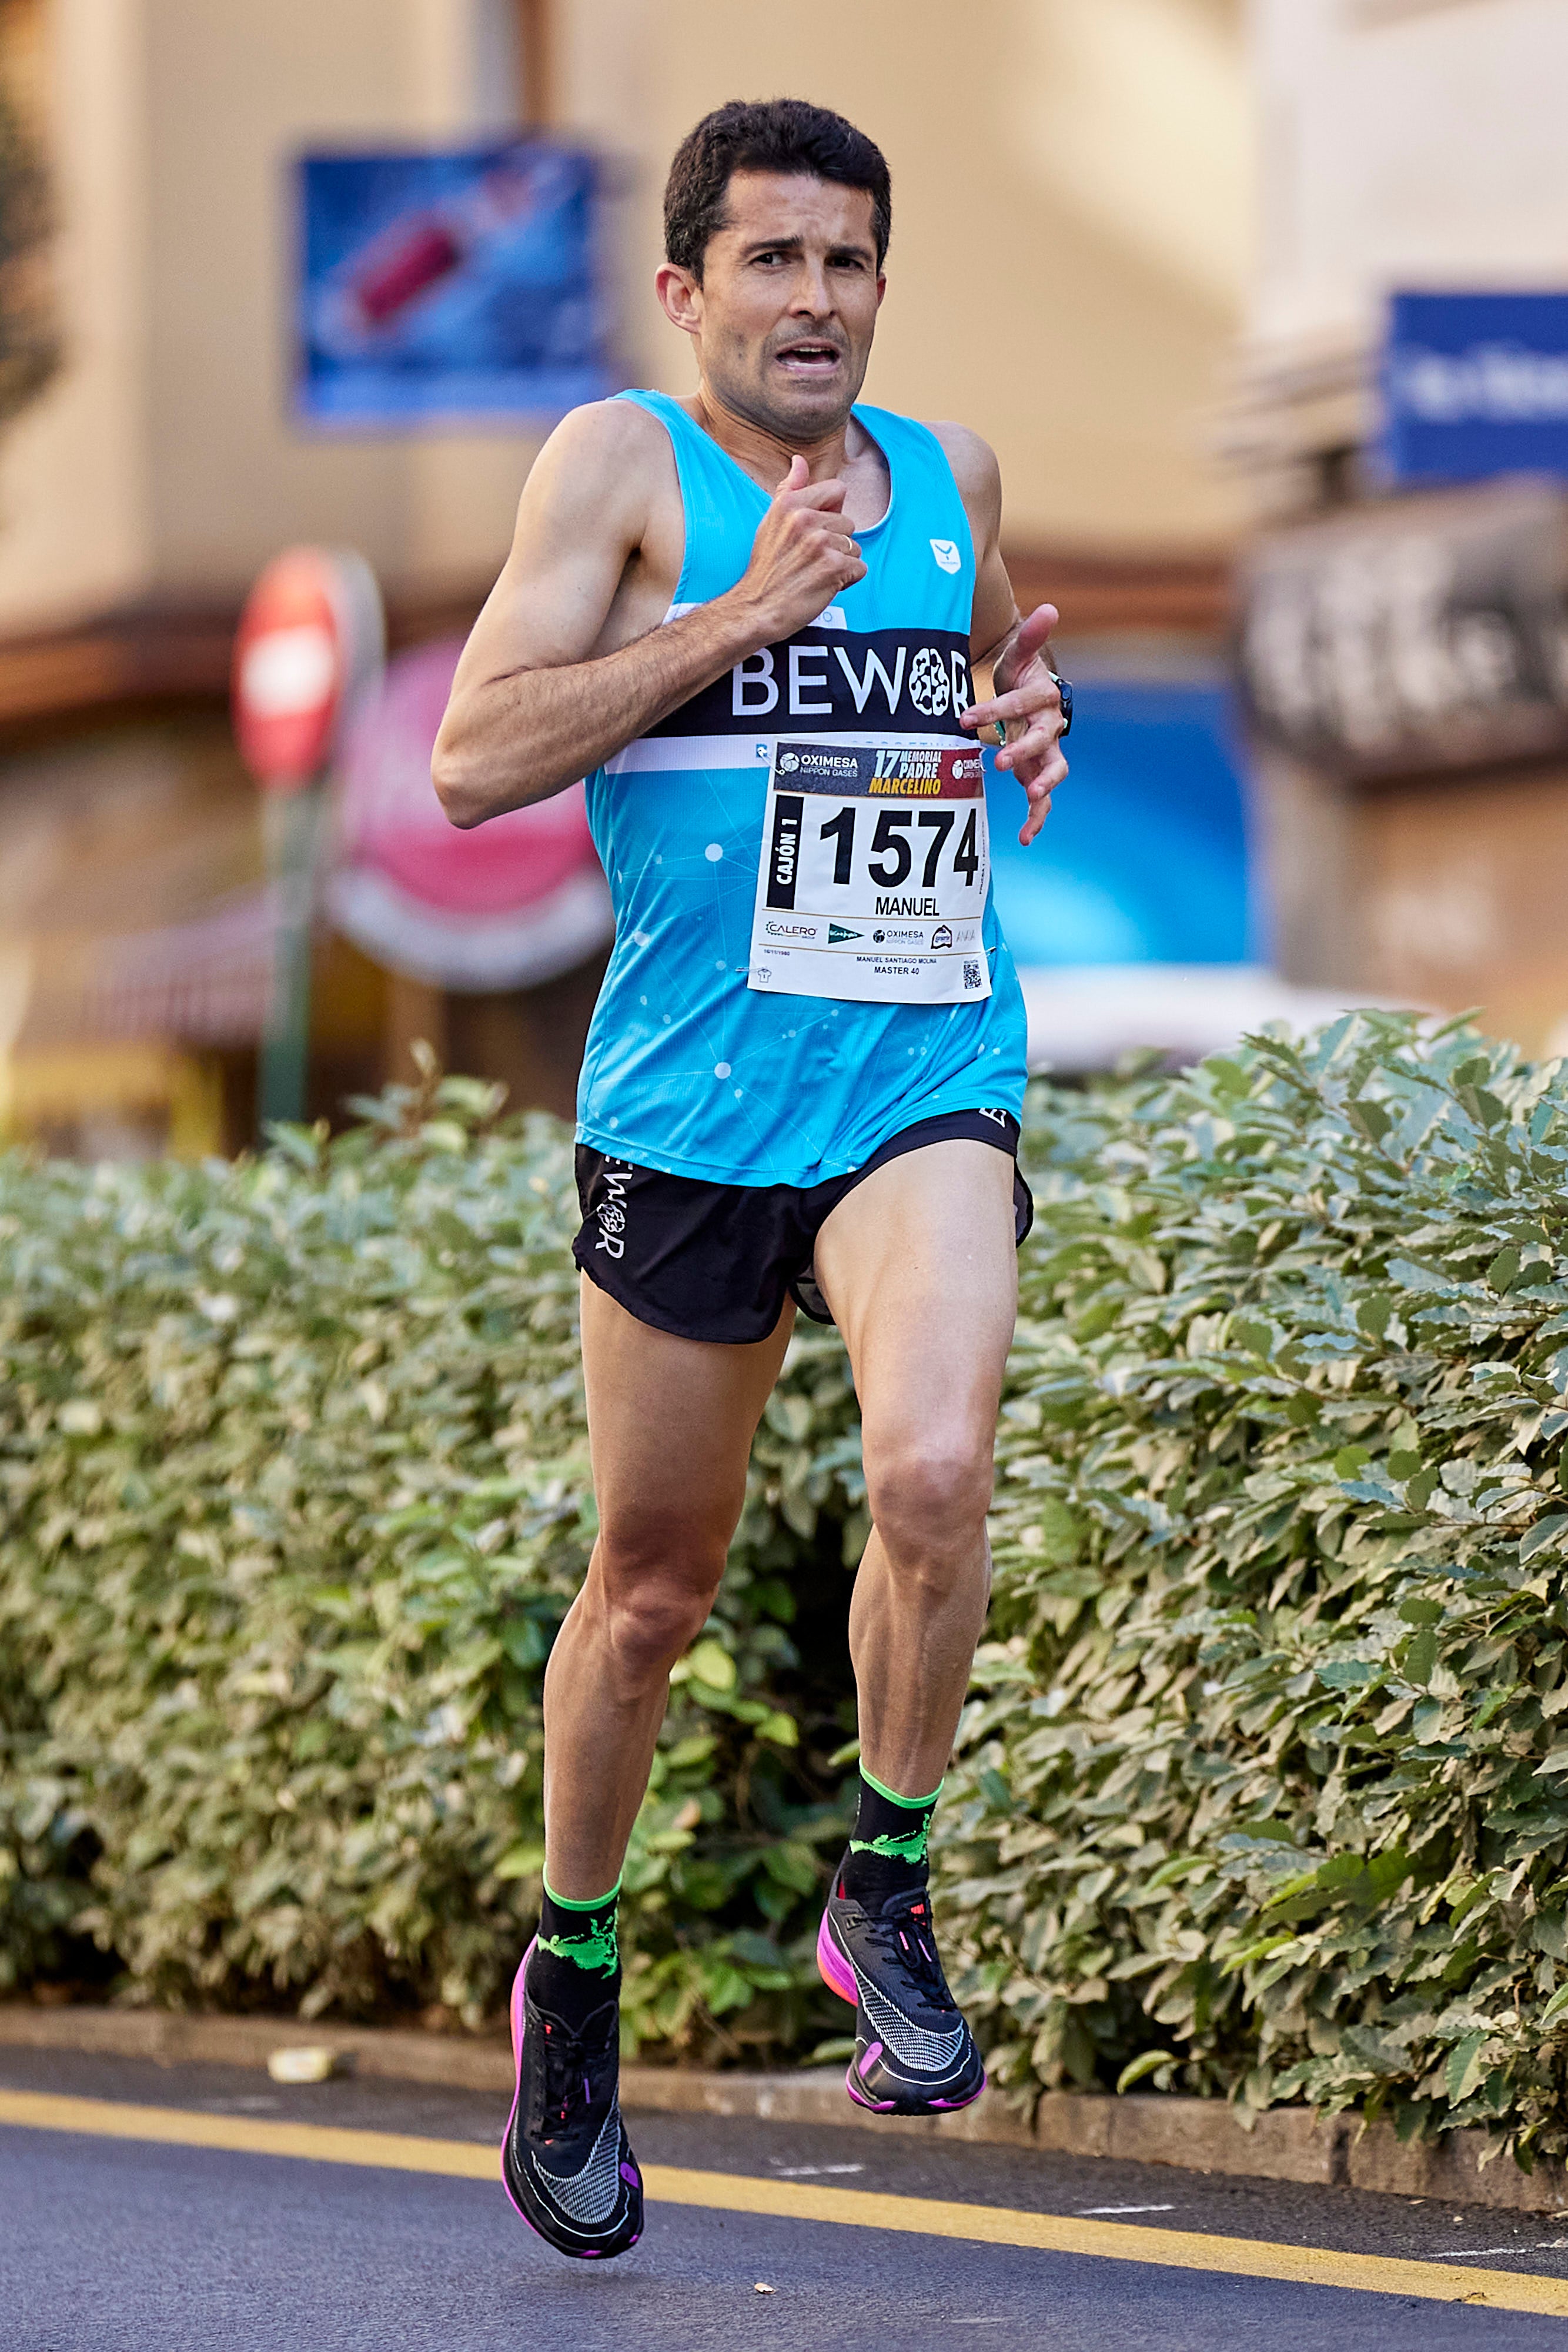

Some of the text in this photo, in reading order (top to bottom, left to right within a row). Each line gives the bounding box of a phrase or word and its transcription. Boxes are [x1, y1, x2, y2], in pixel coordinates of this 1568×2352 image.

[801, 754, 858, 769] OXIMESA
[874, 750, 942, 779] 17 MEMORIAL
[800, 767, 858, 777] NIPPON GASES
[898, 763, 938, 779] PADRE
[868, 777, 941, 795] MARCELINO
[820, 807, 979, 888] 1574
[775, 833, 796, 885] CAJÓN
[875, 897, 940, 916] MANUEL
[769, 923, 817, 936] CALERO
[887, 930, 924, 938] OXIMESA
[874, 966, 909, 974] MASTER
